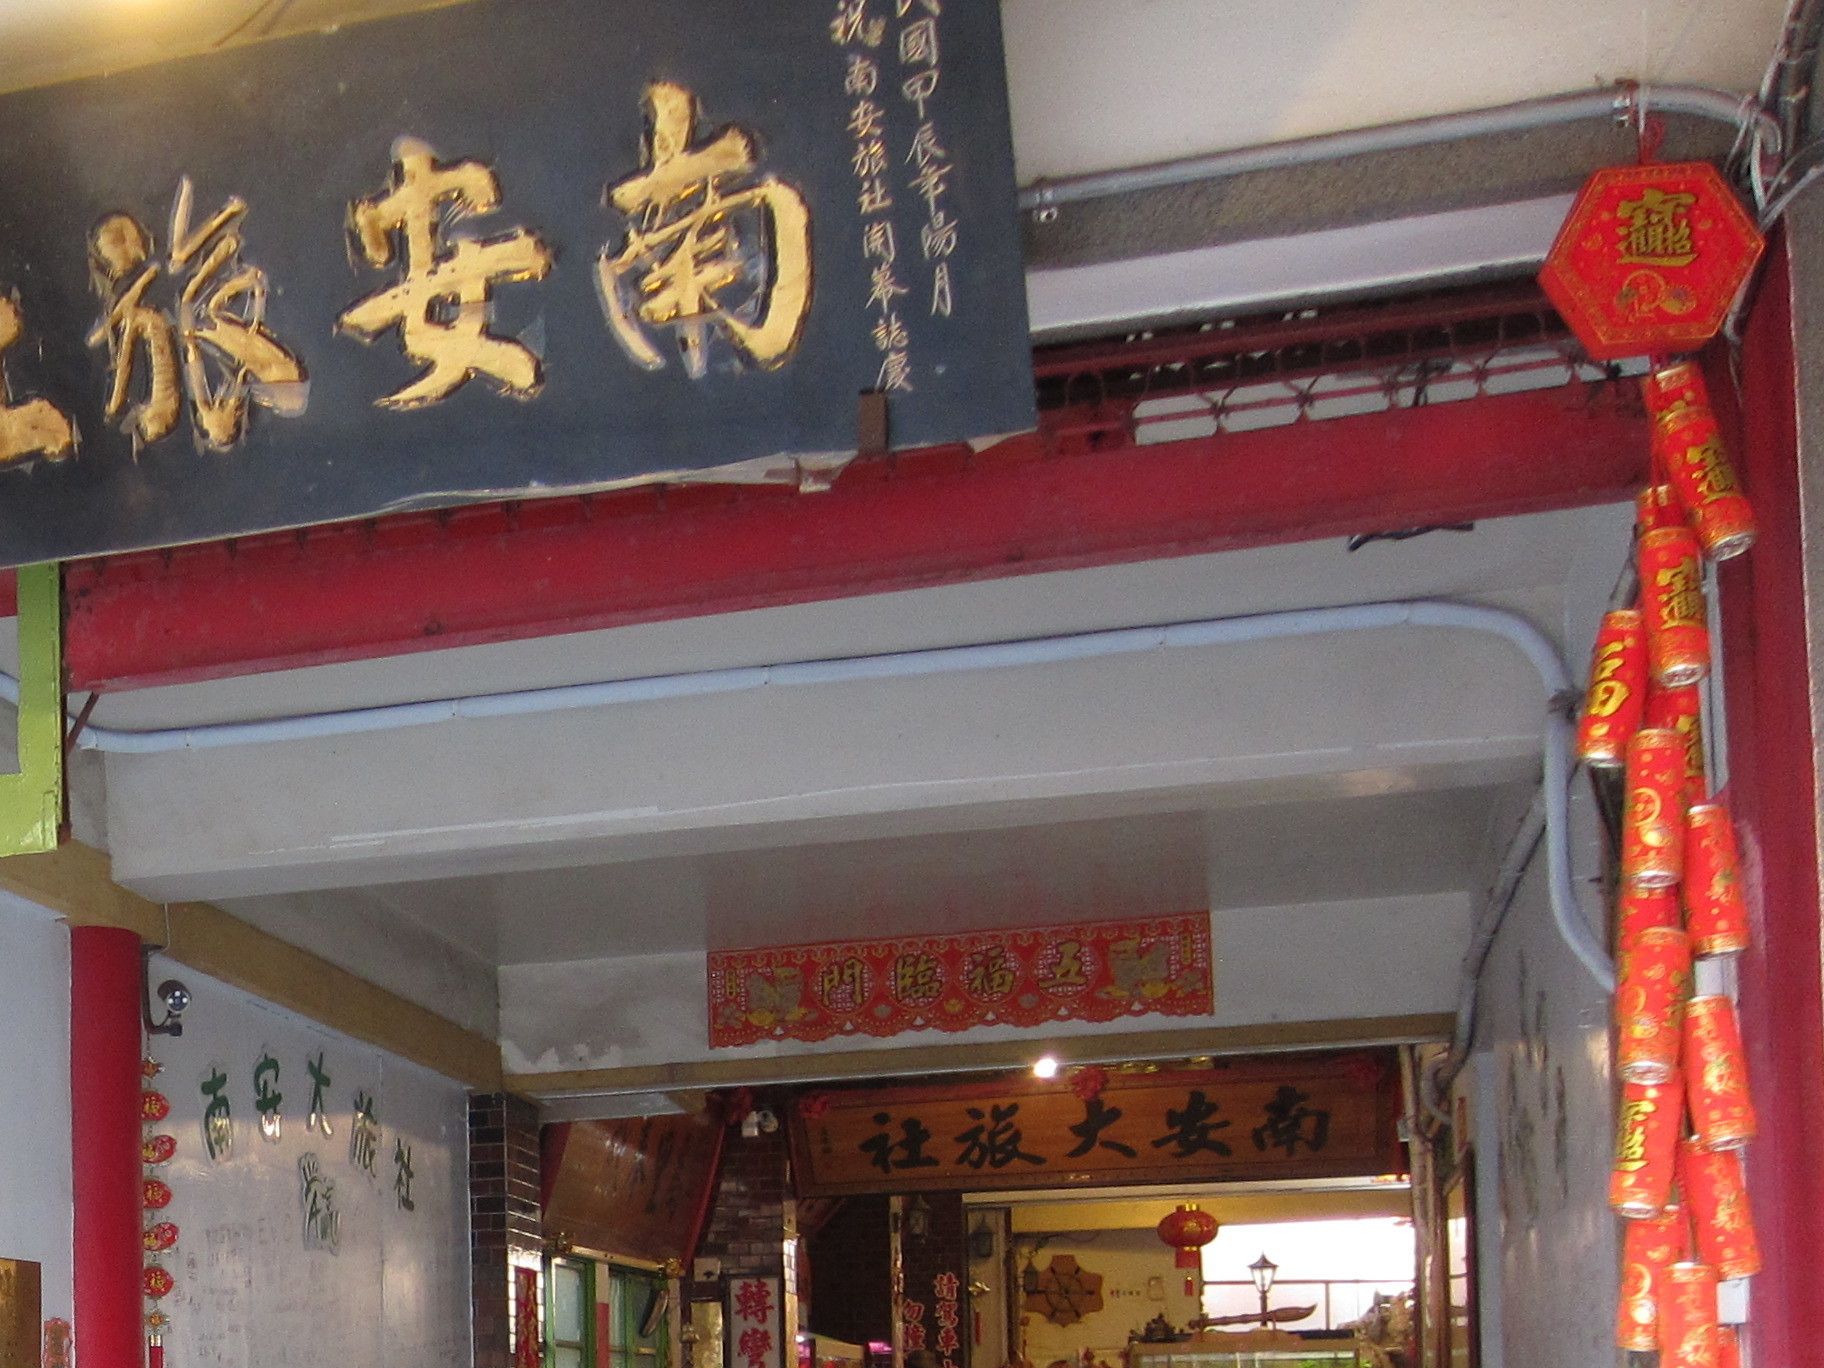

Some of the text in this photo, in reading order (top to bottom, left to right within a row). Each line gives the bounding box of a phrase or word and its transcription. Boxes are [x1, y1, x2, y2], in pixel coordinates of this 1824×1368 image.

[820, 939, 1087, 1006] 五福臨門
[858, 1084, 1333, 1174] 南安大旅社
